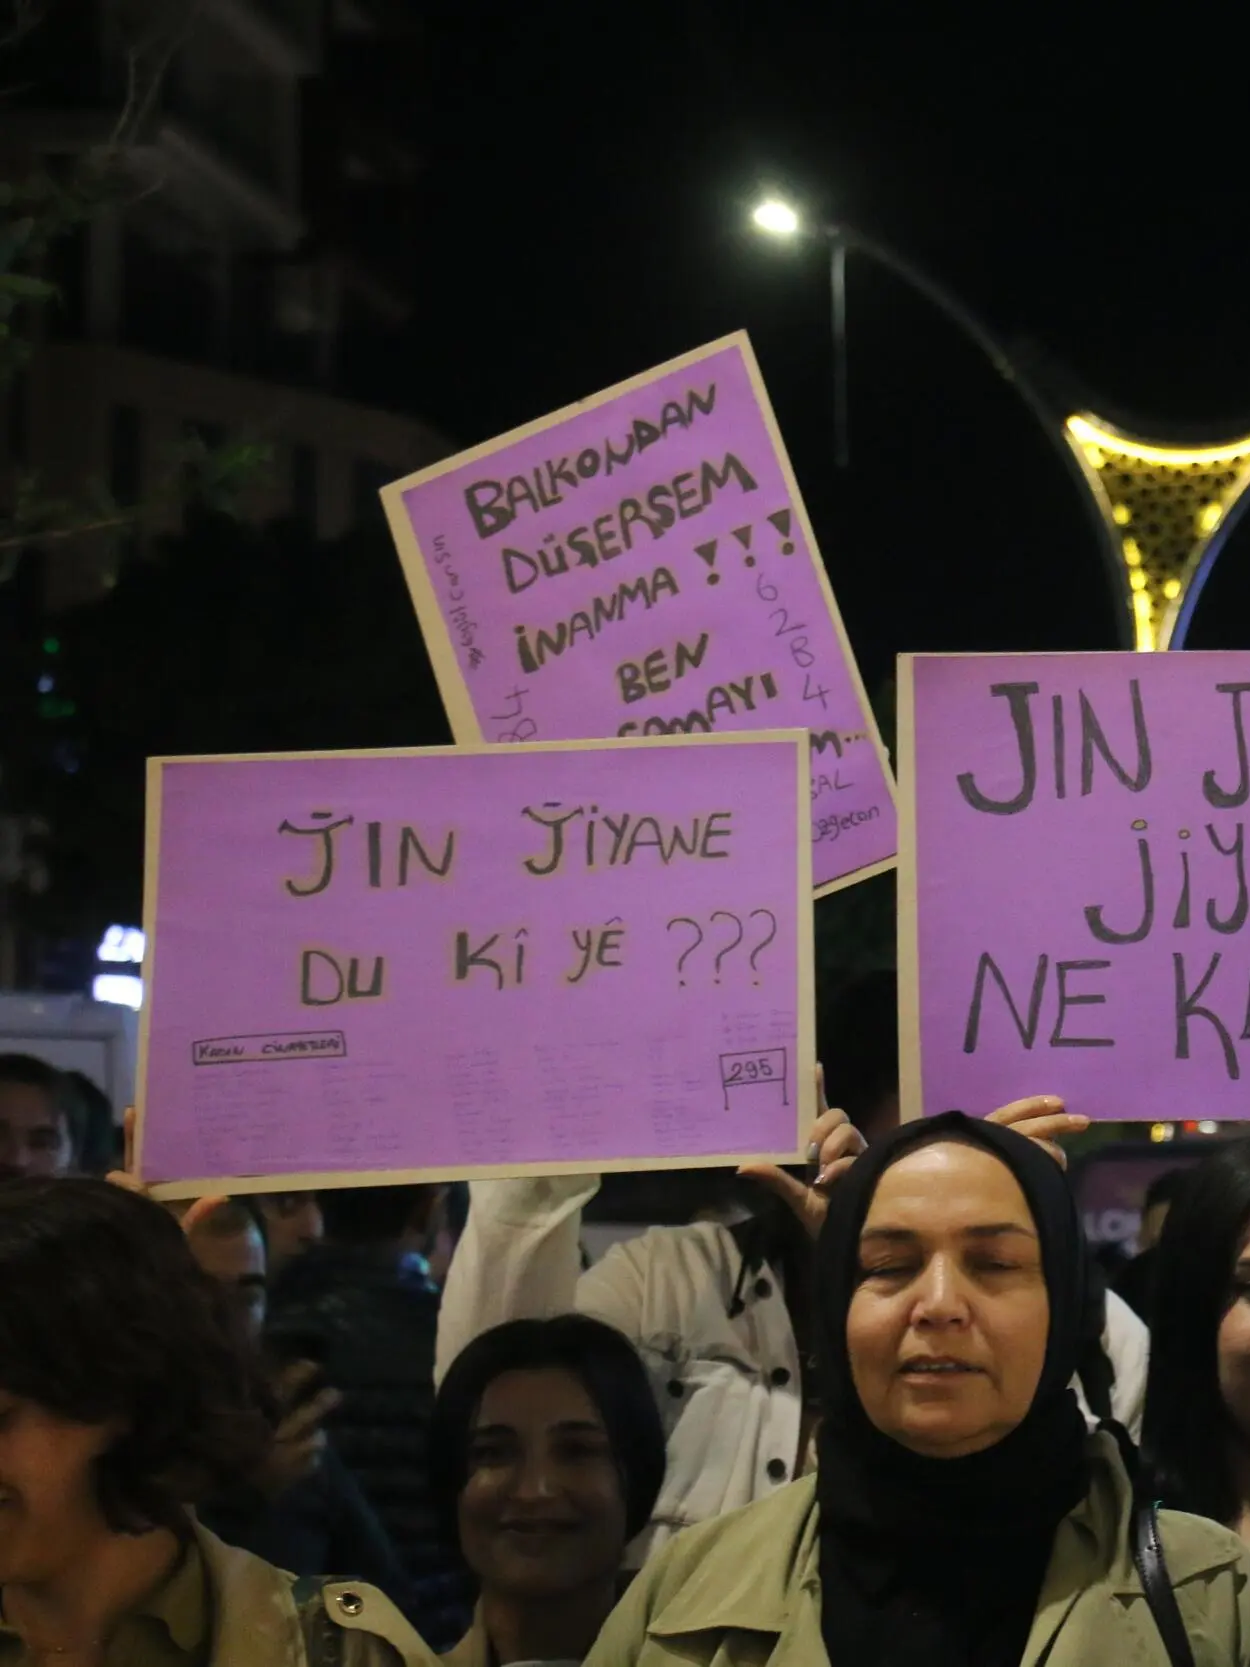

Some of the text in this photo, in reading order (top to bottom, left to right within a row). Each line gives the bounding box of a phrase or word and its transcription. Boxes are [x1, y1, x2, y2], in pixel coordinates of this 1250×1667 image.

[464, 382, 717, 539] BALKONDAN
[502, 453, 758, 594] DÜŞERSEM
[617, 633, 709, 704] BEN
[956, 678, 1153, 816] JIN
[301, 949, 386, 1007] DU
[963, 951, 1115, 1054] NE
[727, 1059, 774, 1082] 295
